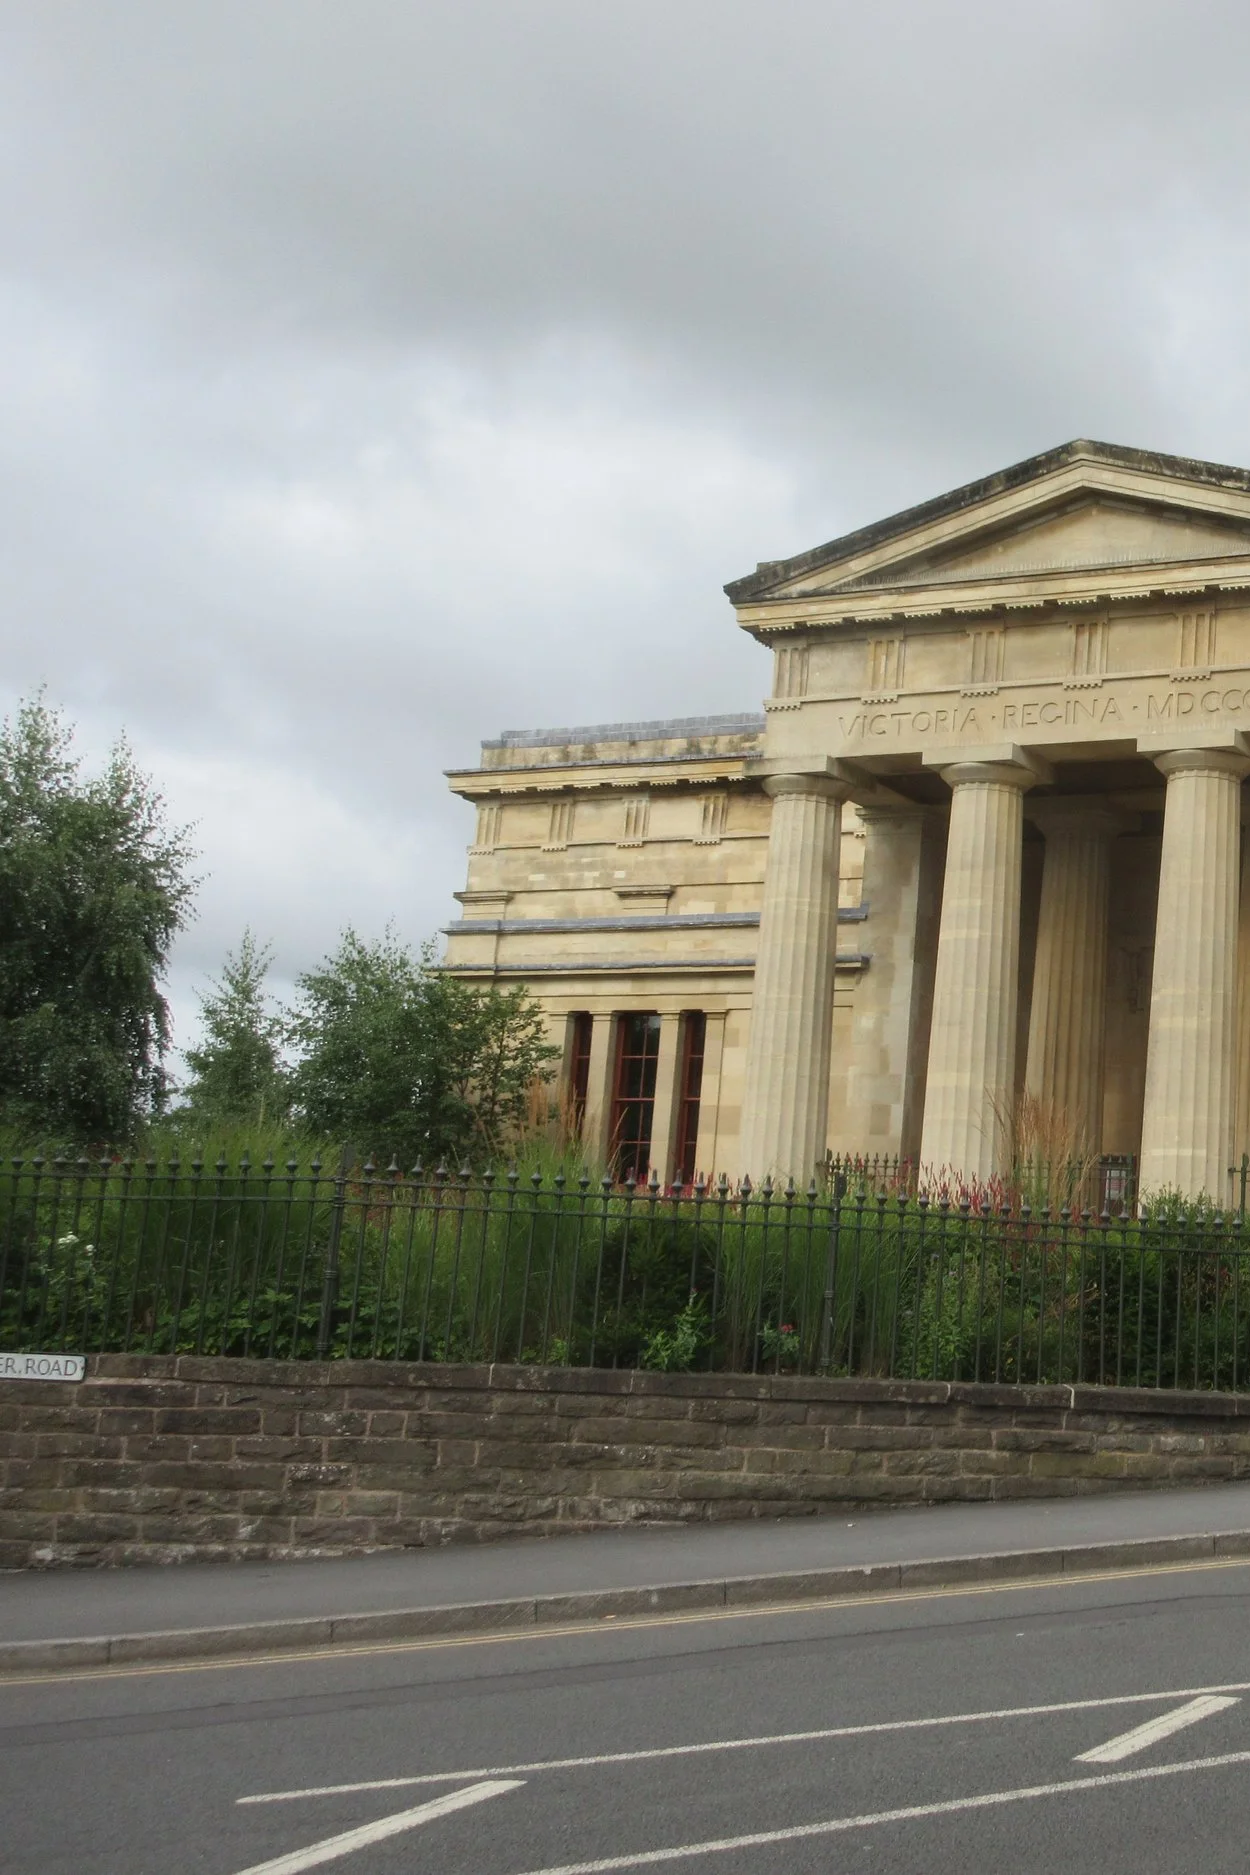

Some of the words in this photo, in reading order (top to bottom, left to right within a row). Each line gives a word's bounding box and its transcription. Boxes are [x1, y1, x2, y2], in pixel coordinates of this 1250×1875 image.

[838, 707, 982, 738] VICTORIA
[1002, 697, 1124, 729] REGINA
[25, 1358, 77, 1376] ROAD
